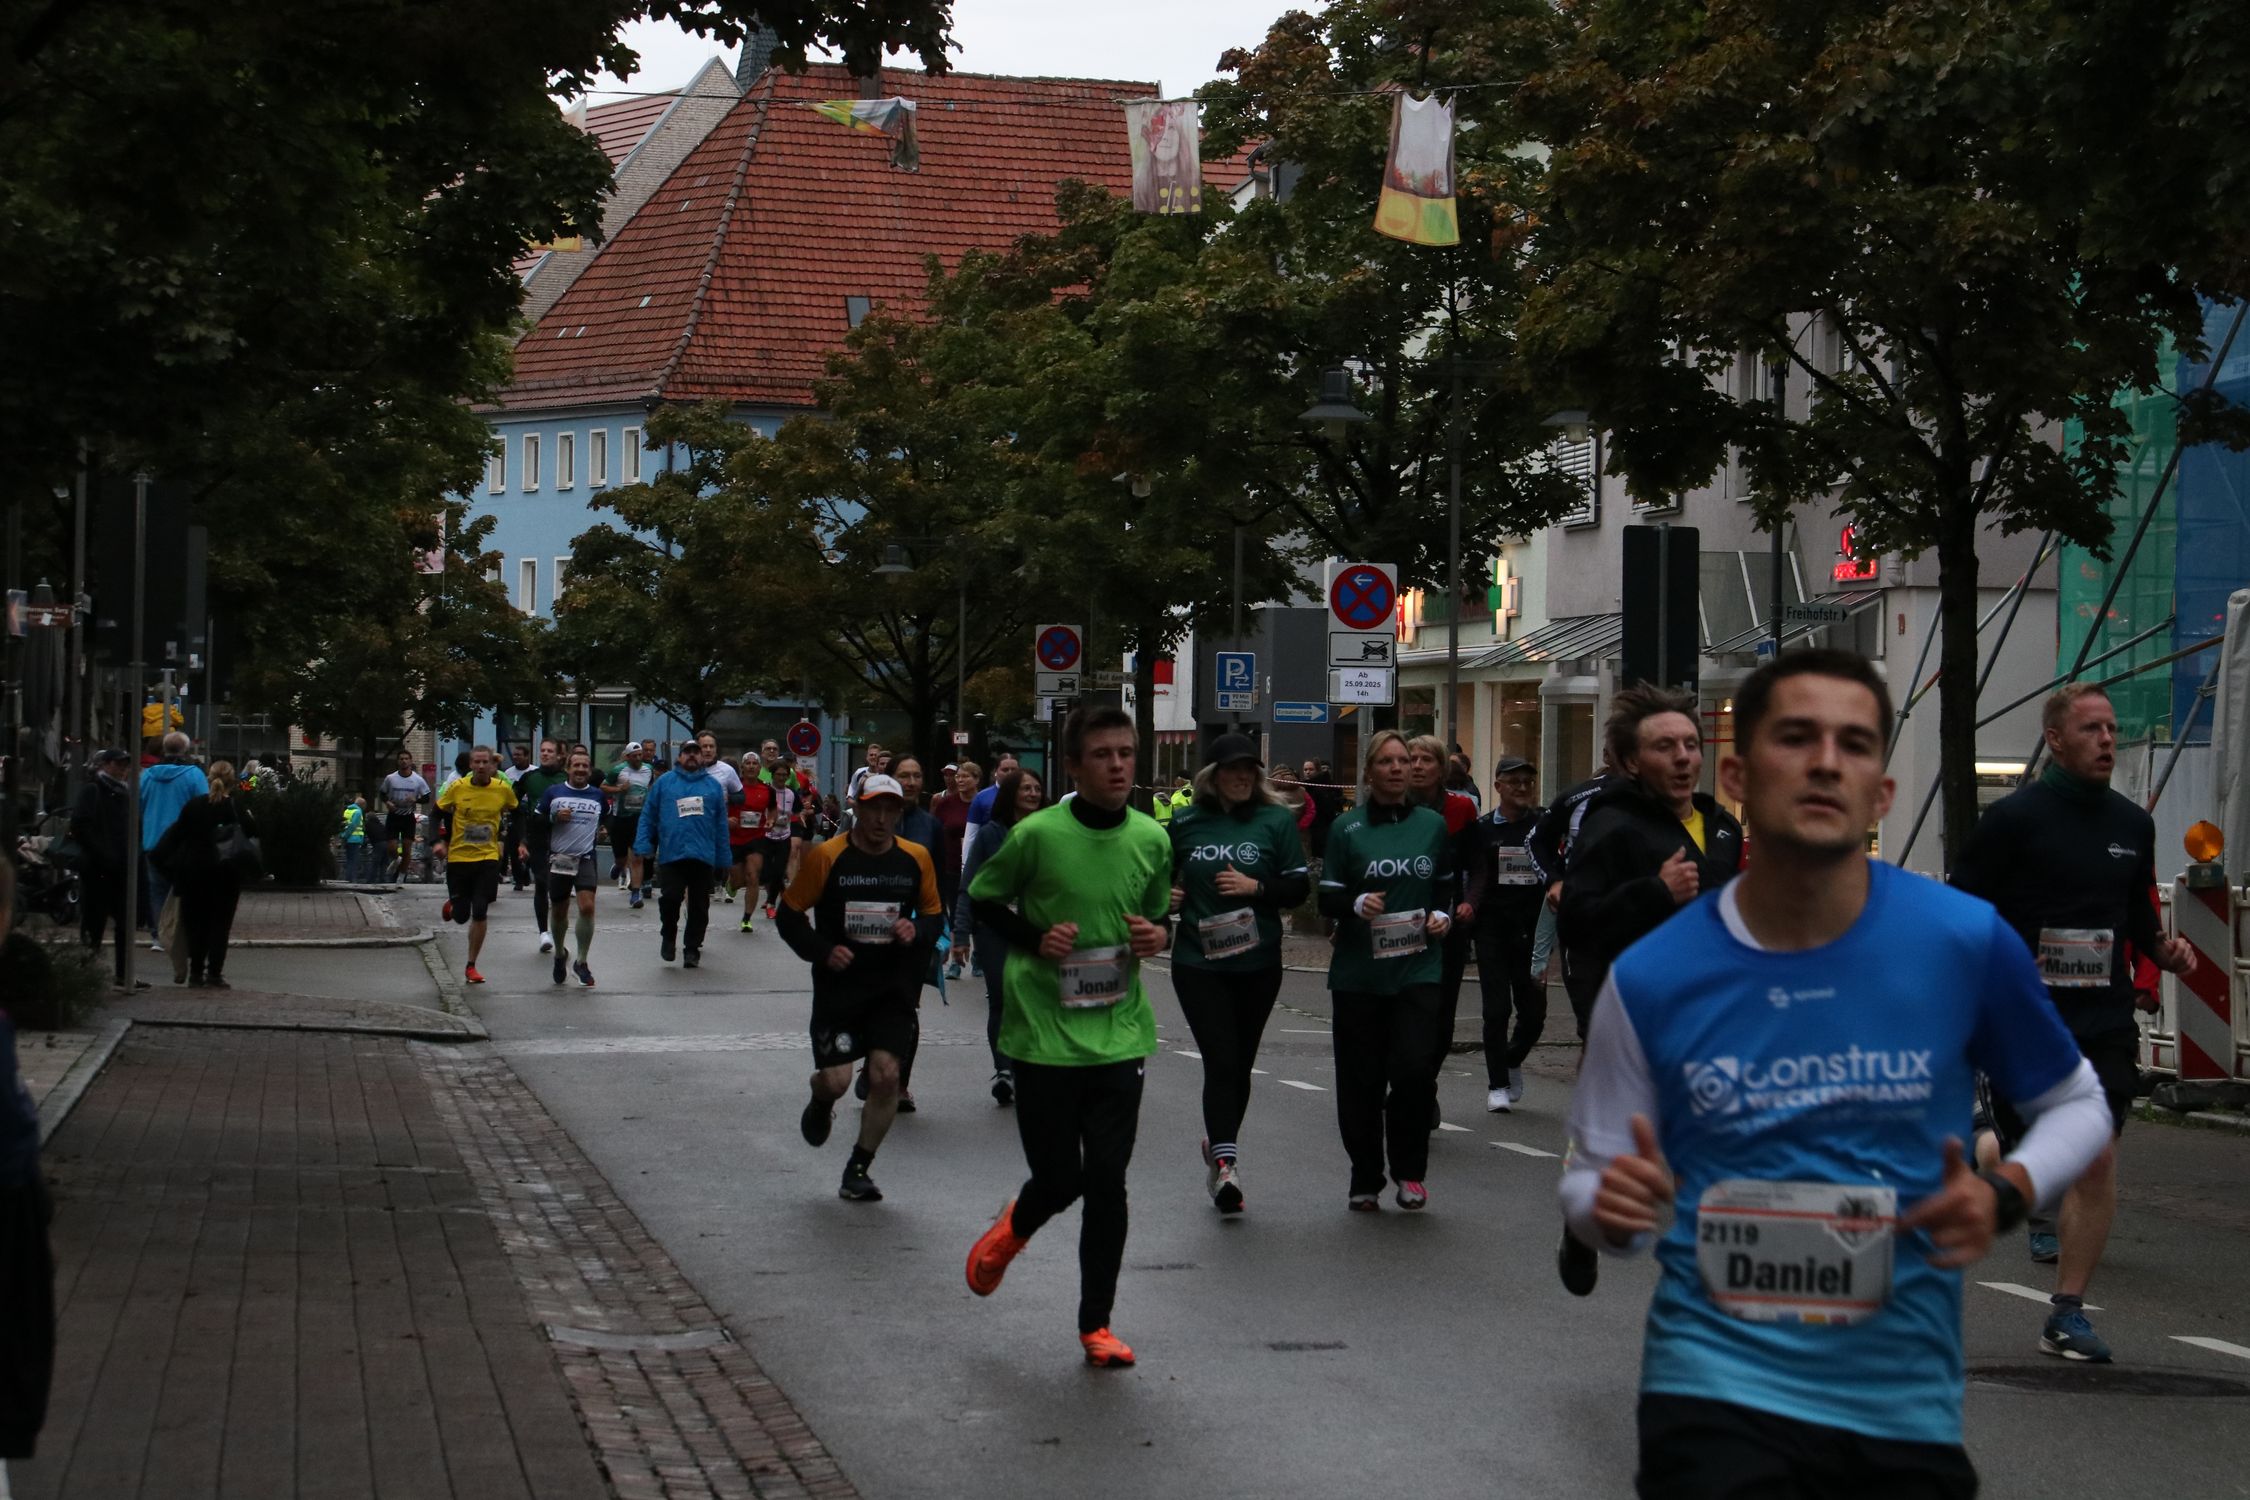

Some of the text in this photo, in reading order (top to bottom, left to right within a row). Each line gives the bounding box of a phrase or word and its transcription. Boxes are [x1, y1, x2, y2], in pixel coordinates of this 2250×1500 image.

[1786, 606, 1839, 622] Freihofstr.
[1226, 658, 1245, 687] P
[1345, 680, 1381, 688] 25.09.2025
[557, 801, 599, 811] KERN
[1190, 844, 1235, 861] AOK
[1364, 859, 1412, 879] AOK
[847, 923, 890, 936] Winfrie
[1209, 931, 1251, 950] Nadine
[1380, 933, 1421, 949] Carolin
[2045, 959, 2104, 976] Markus
[1743, 1043, 1933, 1090] construx
[1702, 1220, 1760, 1246] 2119
[1727, 1251, 1853, 1295] Daniel
